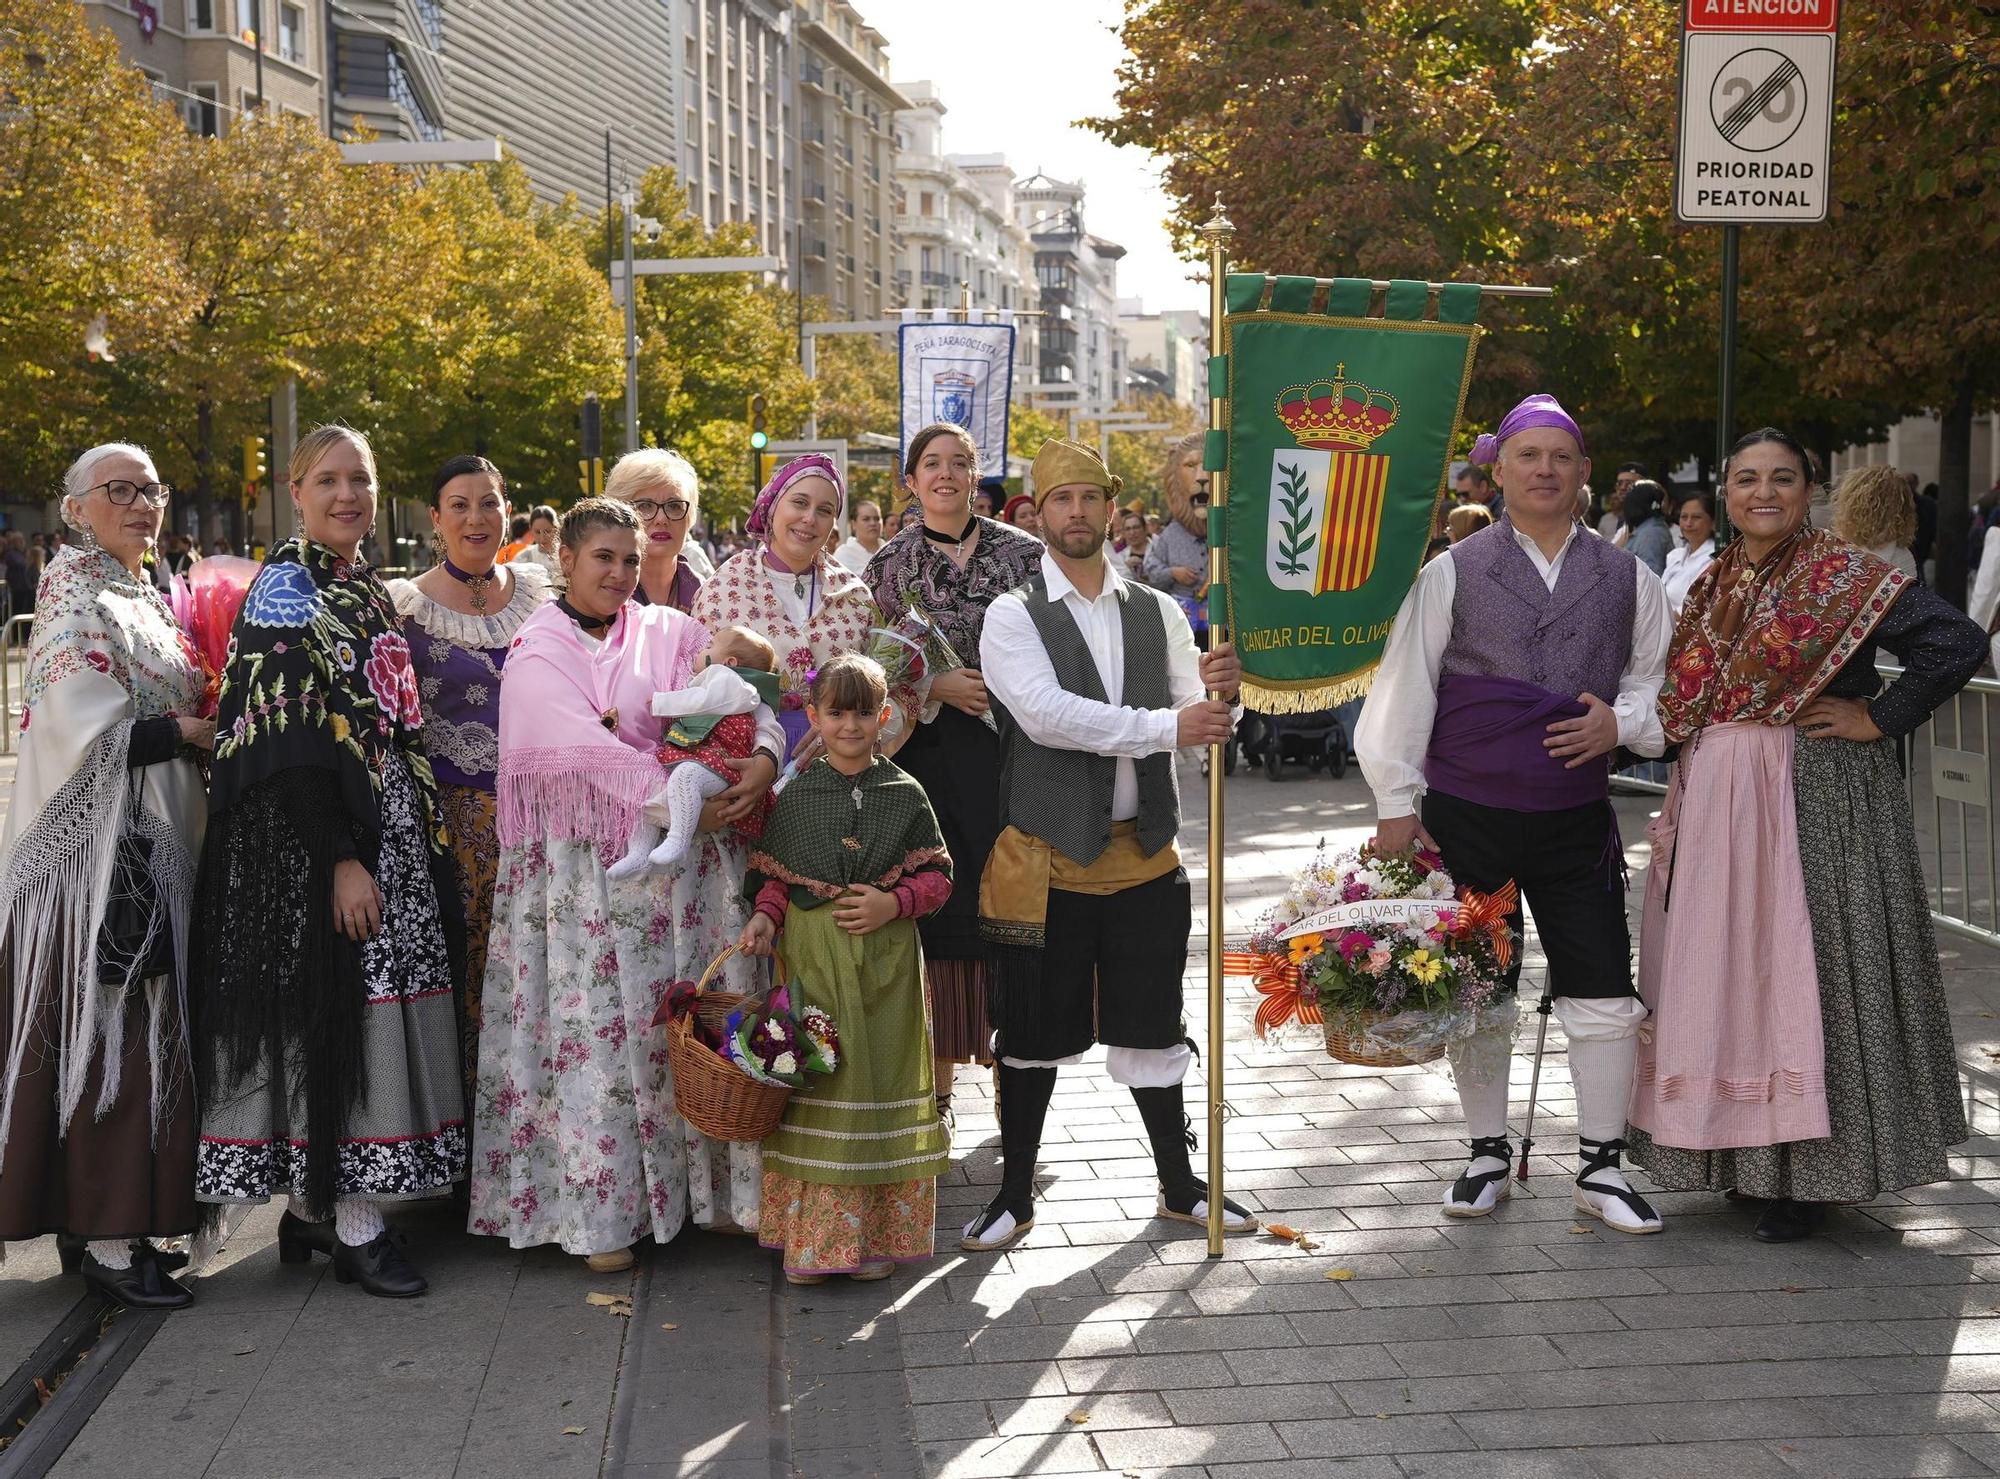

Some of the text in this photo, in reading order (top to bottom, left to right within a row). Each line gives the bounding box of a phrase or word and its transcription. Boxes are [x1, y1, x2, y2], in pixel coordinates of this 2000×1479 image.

[1722, 76, 1796, 123] 20
[1696, 162, 1814, 178] PRIORIDAD
[1697, 190, 1811, 207] PEATONAL
[914, 336, 998, 356] PEÑA ZARAGOCISTA
[1242, 626, 1292, 652] CAÑIZAR
[1298, 626, 1336, 646] DEL
[1318, 913, 1346, 930] DEL
[1349, 904, 1404, 920] OLIVAR
